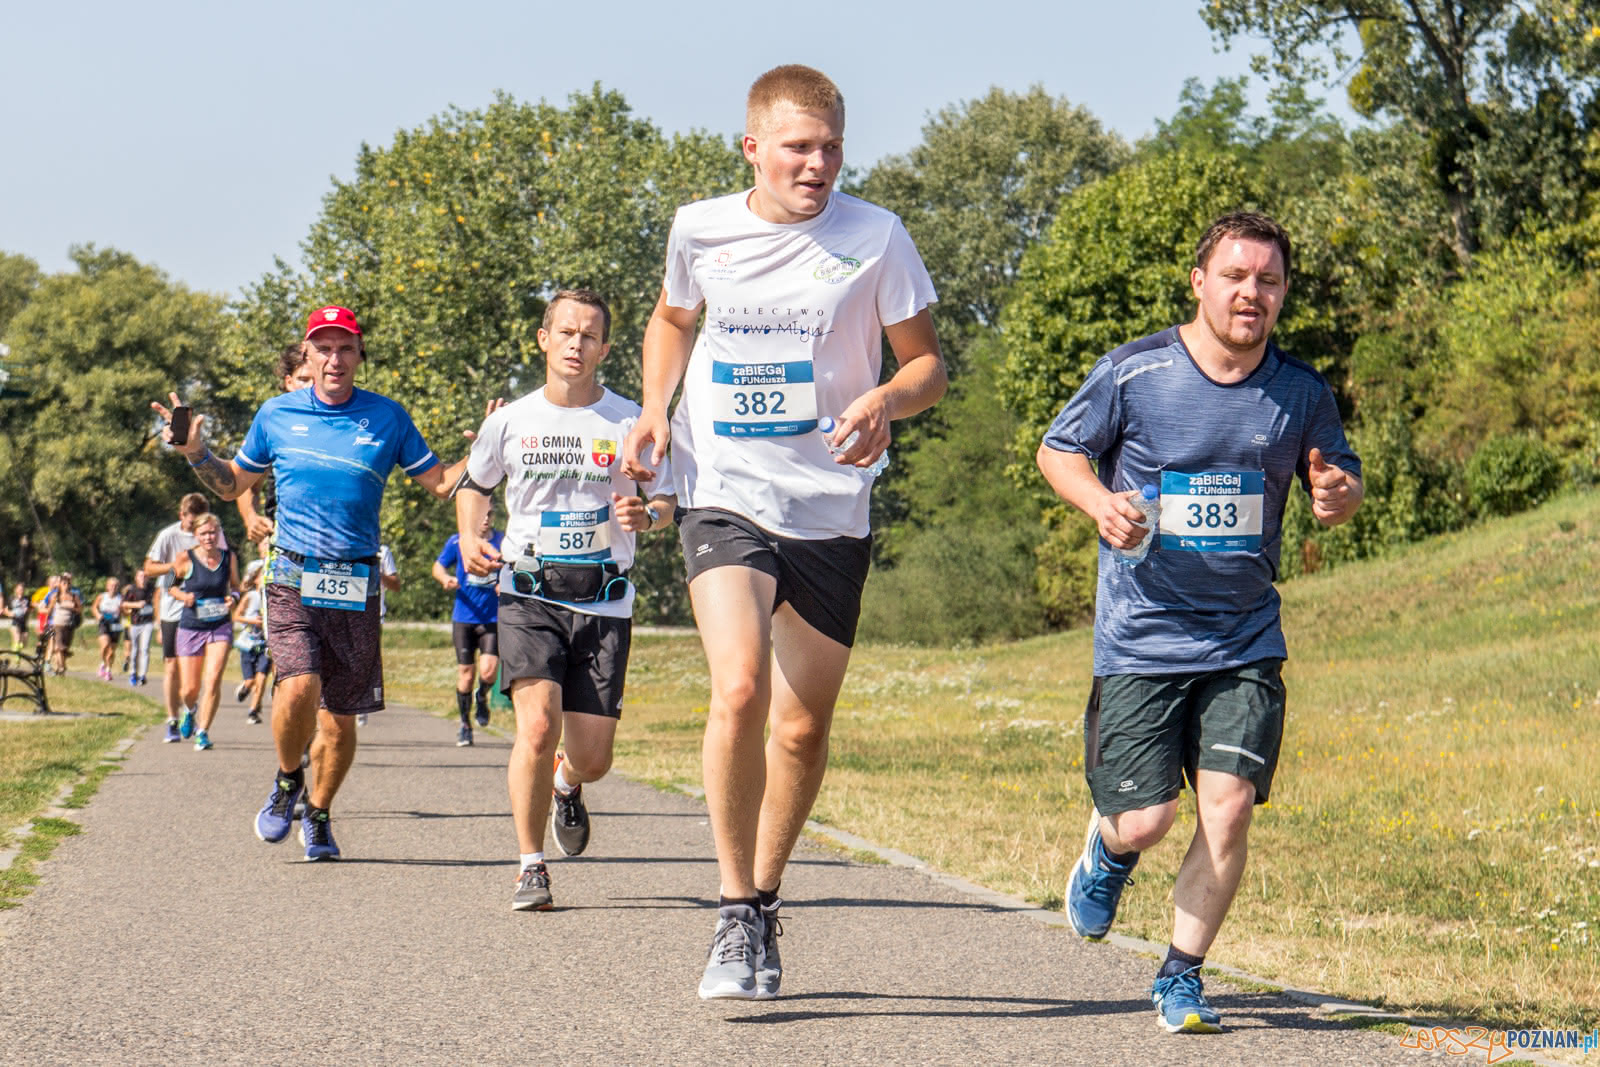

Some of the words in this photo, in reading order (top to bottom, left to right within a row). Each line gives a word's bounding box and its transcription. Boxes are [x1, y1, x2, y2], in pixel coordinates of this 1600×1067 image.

[717, 306, 825, 317] SOŁECTWO
[718, 321, 771, 335] Borowo
[776, 321, 833, 342] Młyn
[732, 364, 786, 377] zaBIEGaj
[733, 390, 786, 416] 382
[521, 436, 538, 449] KB
[542, 436, 582, 449] GMINA
[522, 449, 585, 466] CZARNKÓW
[1189, 474, 1242, 487] zaBIEGaj
[1186, 502, 1238, 529] 383
[559, 531, 596, 550] 587
[316, 578, 349, 596] 435
